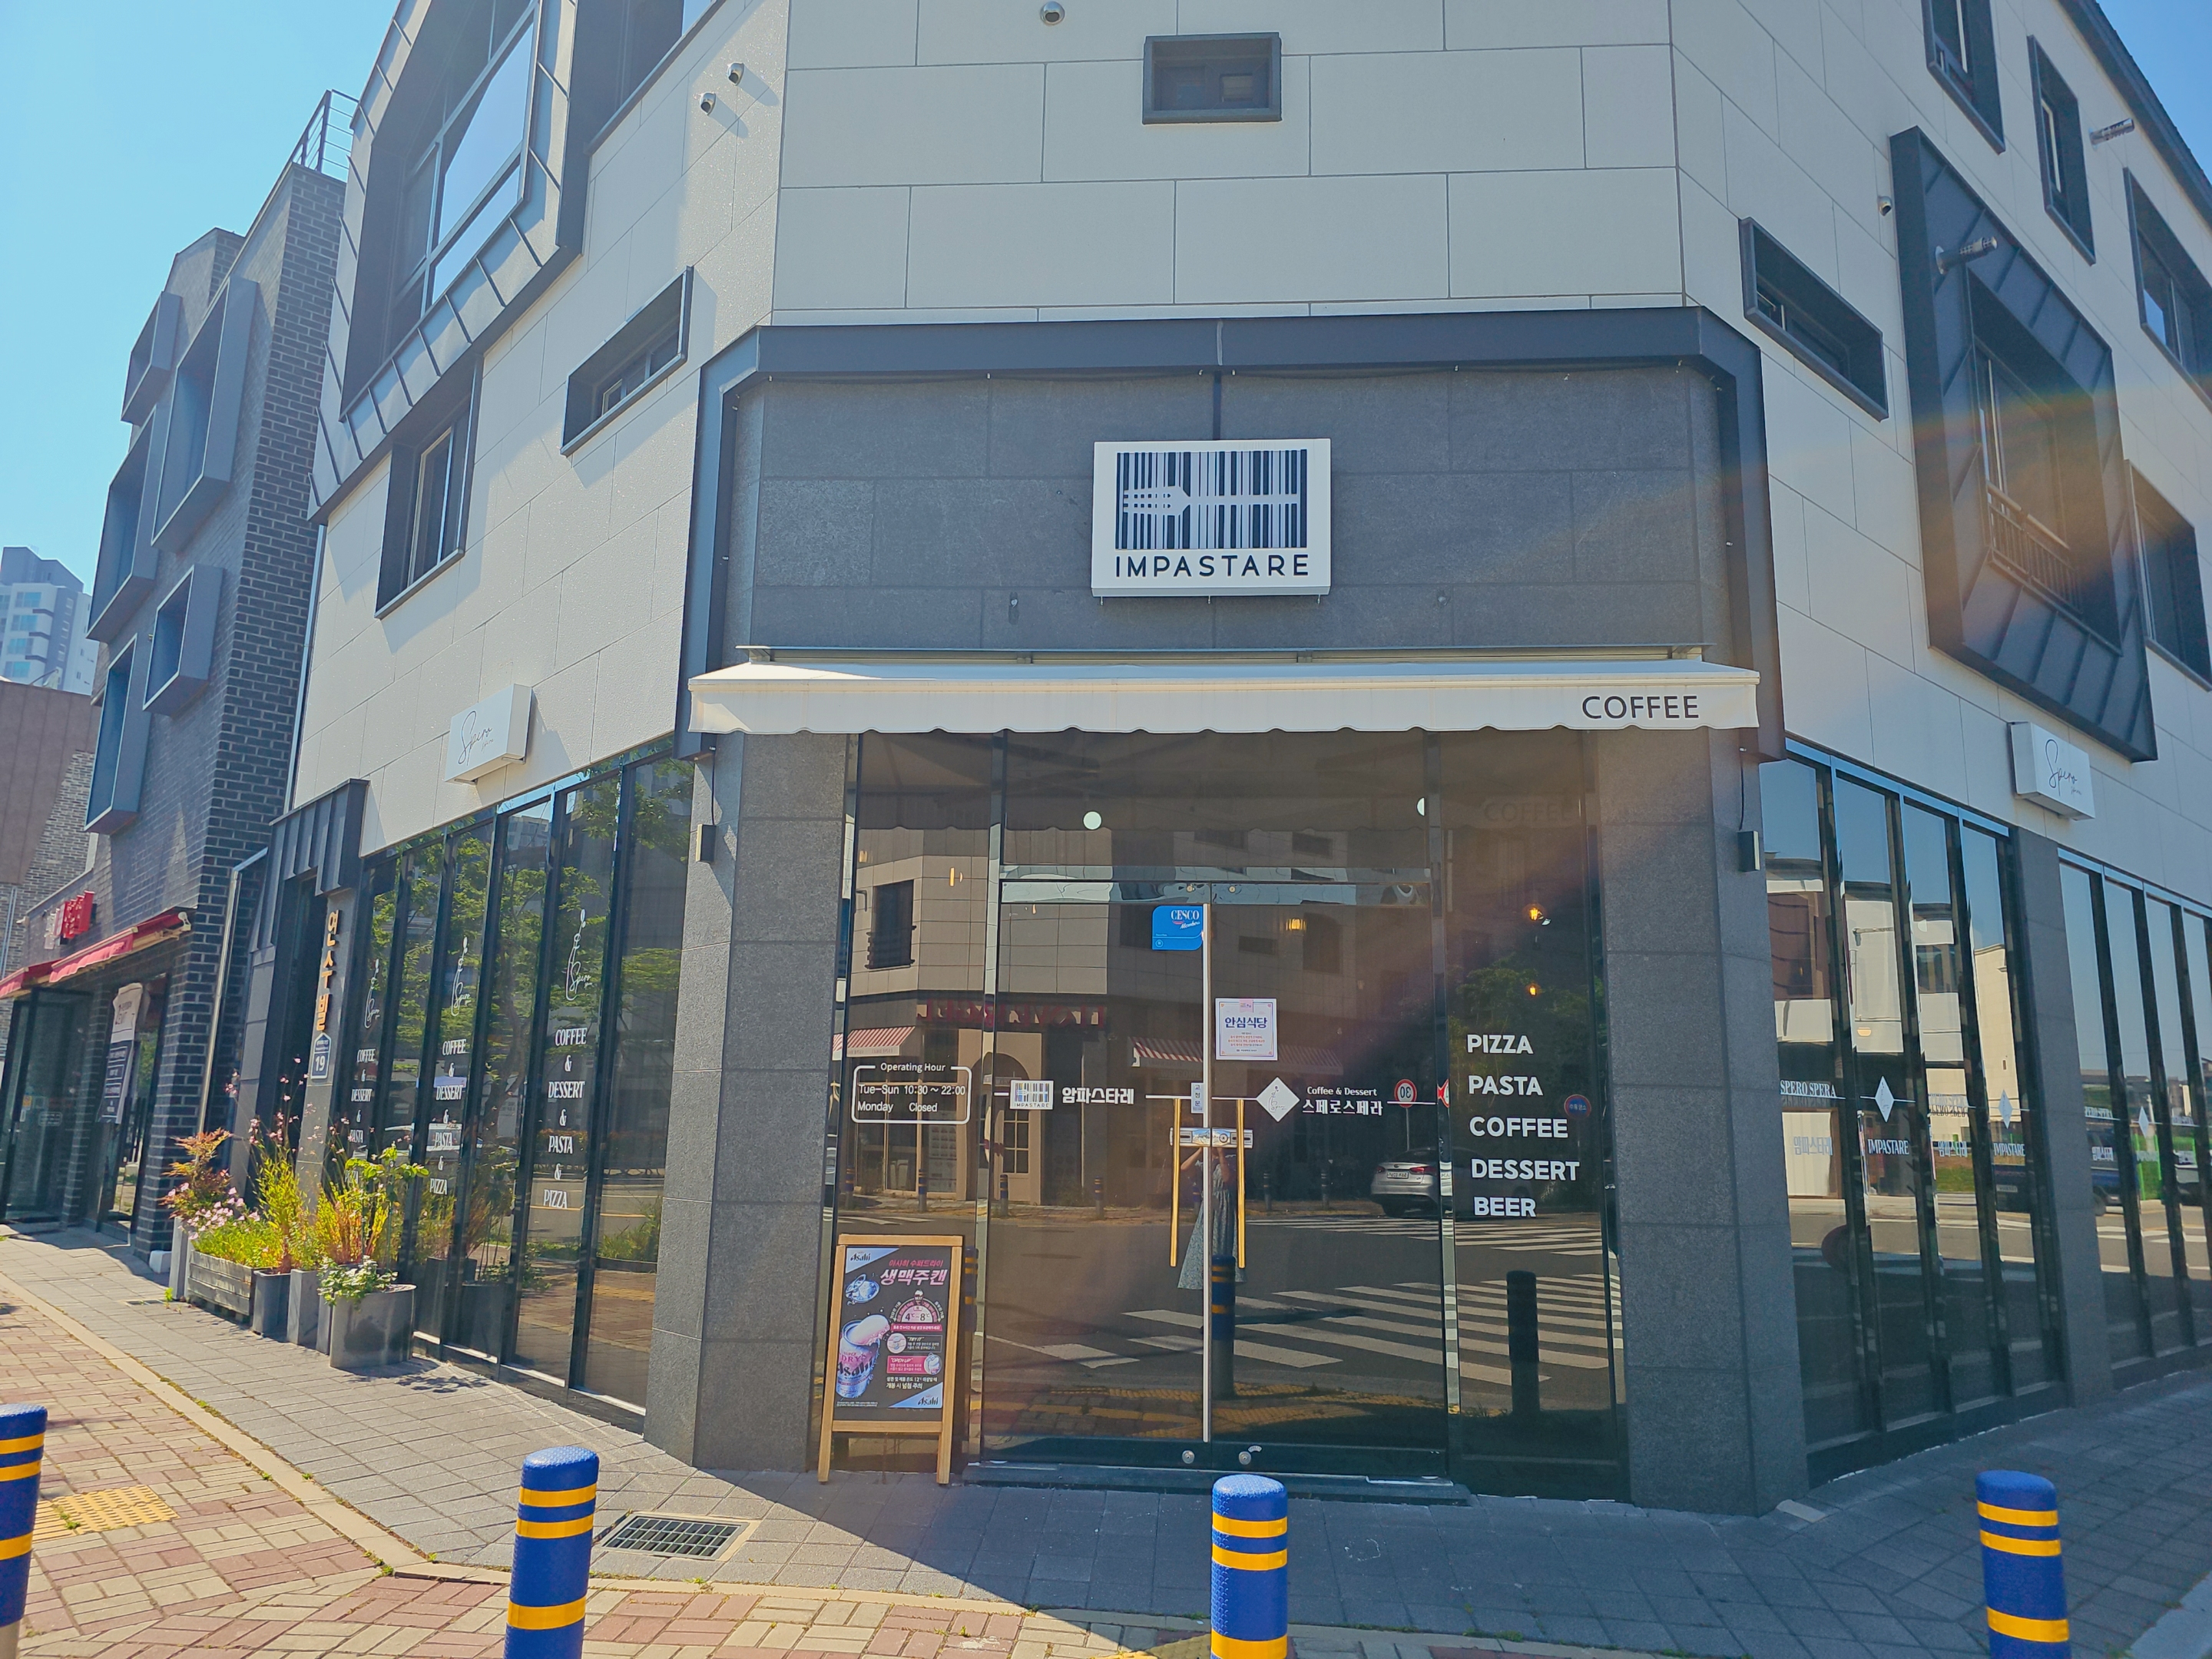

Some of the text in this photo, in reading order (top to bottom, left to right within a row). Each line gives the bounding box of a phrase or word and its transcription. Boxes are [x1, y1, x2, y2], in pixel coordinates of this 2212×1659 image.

[1116, 554, 1308, 577] IMPASTARE
[1582, 695, 1699, 719] COFFEE
[1171, 909, 1200, 920] CESCO
[1224, 1016, 1268, 1028] 안심식당
[555, 1028, 587, 1046] COFFEE
[1467, 1034, 1534, 1054] PIZZA
[357, 1048, 376, 1063] COFFEE
[442, 1039, 467, 1055] COFFEE
[315, 1055, 326, 1072] 19
[449, 1062, 455, 1078] &
[565, 1055, 572, 1072] &
[881, 1063, 945, 1073] Operating Hour
[435, 1084, 464, 1101] DESSERT
[548, 1081, 585, 1098] DESSERT
[859, 1084, 899, 1094] Tue-Sun
[904, 1085, 928, 1094] 10:30
[941, 1085, 965, 1095] 22:00
[1307, 1086, 1377, 1096] Coffee & Dessert
[1469, 1075, 1544, 1096] PASTA
[1780, 1079, 1836, 1098] SPERO SPERA
[351, 1088, 373, 1102] DESSERT
[1061, 1087, 1134, 1105] 암파스타레
[858, 1101, 938, 1113] Monday Closed
[1302, 1099, 1383, 1116] 스페로스페라
[443, 1108, 449, 1124] &
[559, 1108, 567, 1127] &
[1469, 1116, 1568, 1138] COFFEE
[435, 1132, 452, 1147] PASTA
[548, 1135, 573, 1154] PASTA
[1793, 1136, 1833, 1156] 암파스타레
[1867, 1139, 1909, 1155] IMPASTARE
[1993, 1143, 2025, 1157] IMPASTARE
[438, 1155, 444, 1171] &
[1471, 1158, 1580, 1181] DESSERT
[555, 1163, 561, 1181] &
[430, 1177, 448, 1195] PIZZA
[543, 1189, 568, 1209] PIZZA
[1474, 1197, 1536, 1217] BEER
[850, 1253, 871, 1261] Asahi
[880, 1269, 948, 1286] 생맥주캔
[841, 1354, 861, 1363] DRY
[918, 1396, 939, 1406] Asahi
